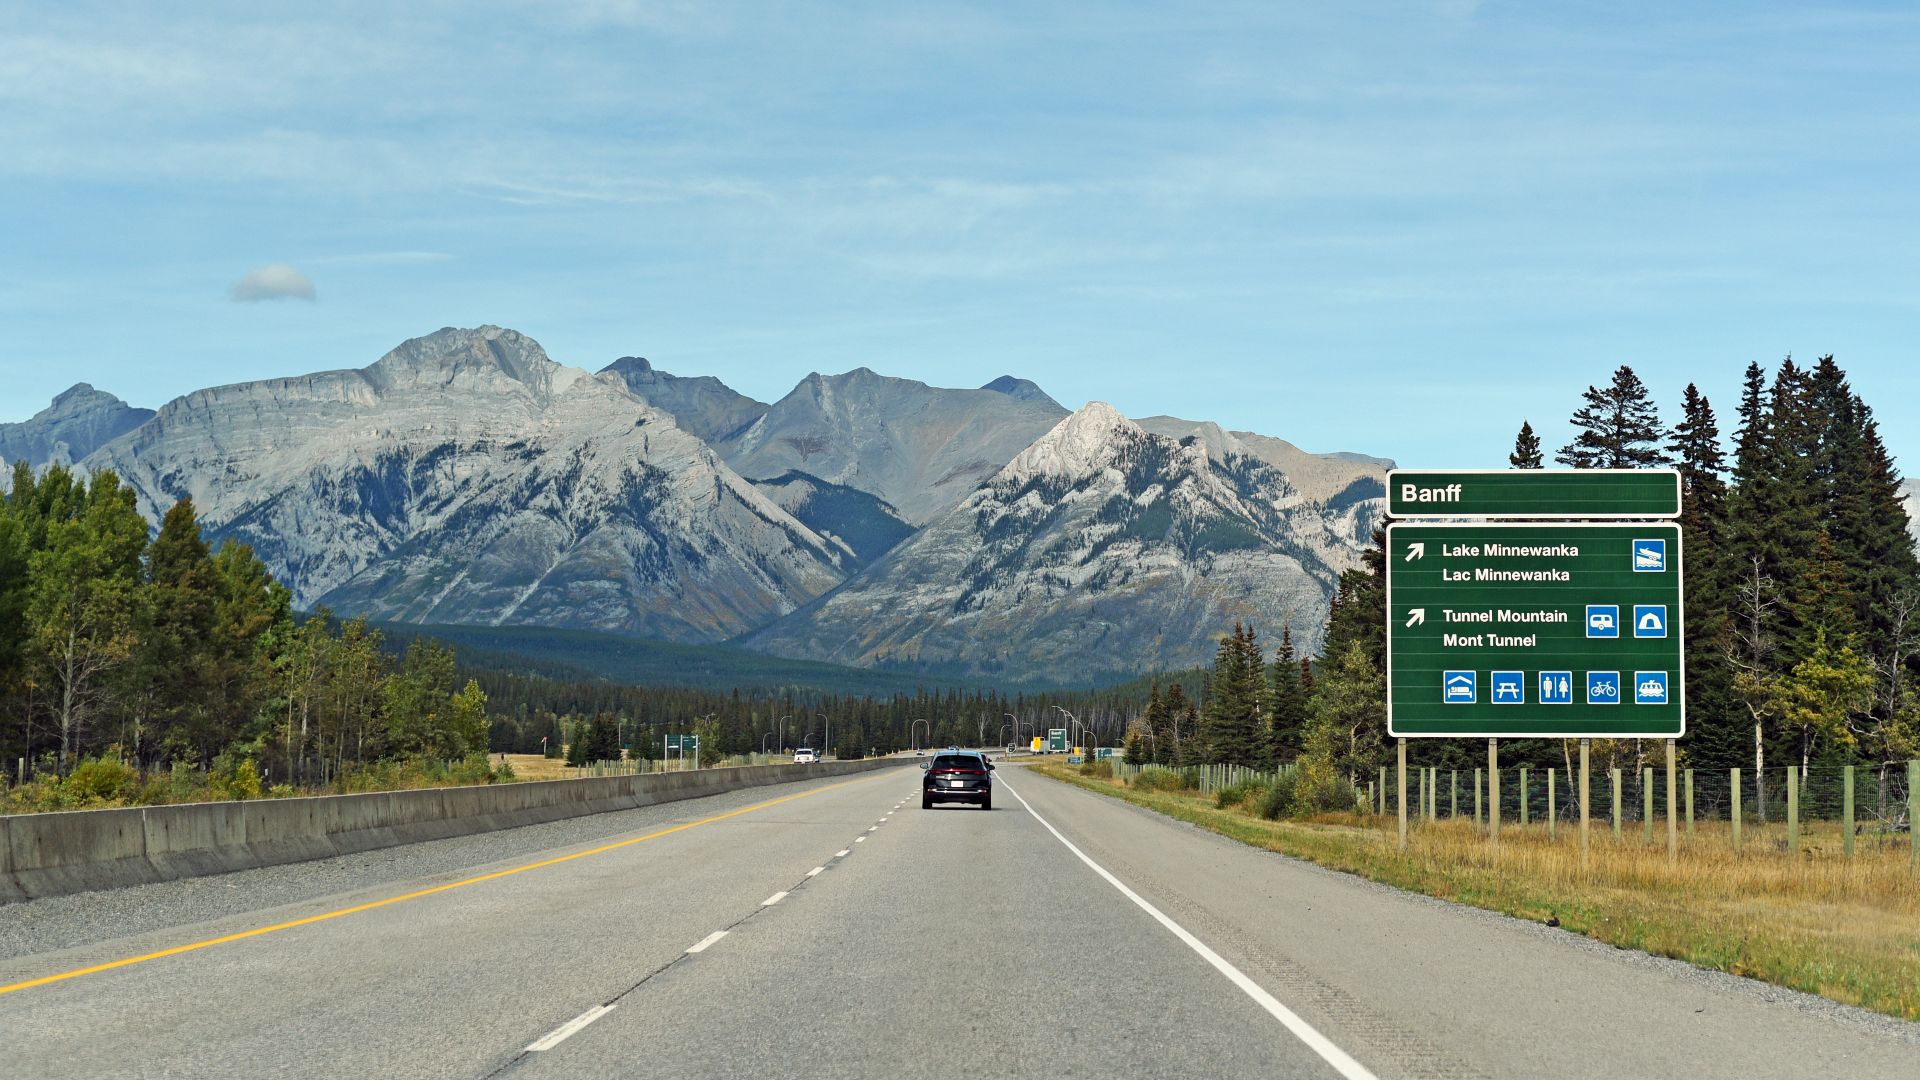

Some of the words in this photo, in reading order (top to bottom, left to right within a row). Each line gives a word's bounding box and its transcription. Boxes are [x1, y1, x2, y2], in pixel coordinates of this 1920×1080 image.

[1401, 483, 1462, 502] Banff
[1442, 544, 1480, 557] Lake
[1483, 544, 1579, 557] Minnewanka
[1442, 568, 1471, 581] Lac
[1475, 568, 1570, 581] Minnewanka
[1442, 609, 1493, 622] Tunnel
[1497, 609, 1568, 622] Mountain
[1443, 633, 1483, 647] Mont
[1486, 633, 1536, 647] Tunnel
